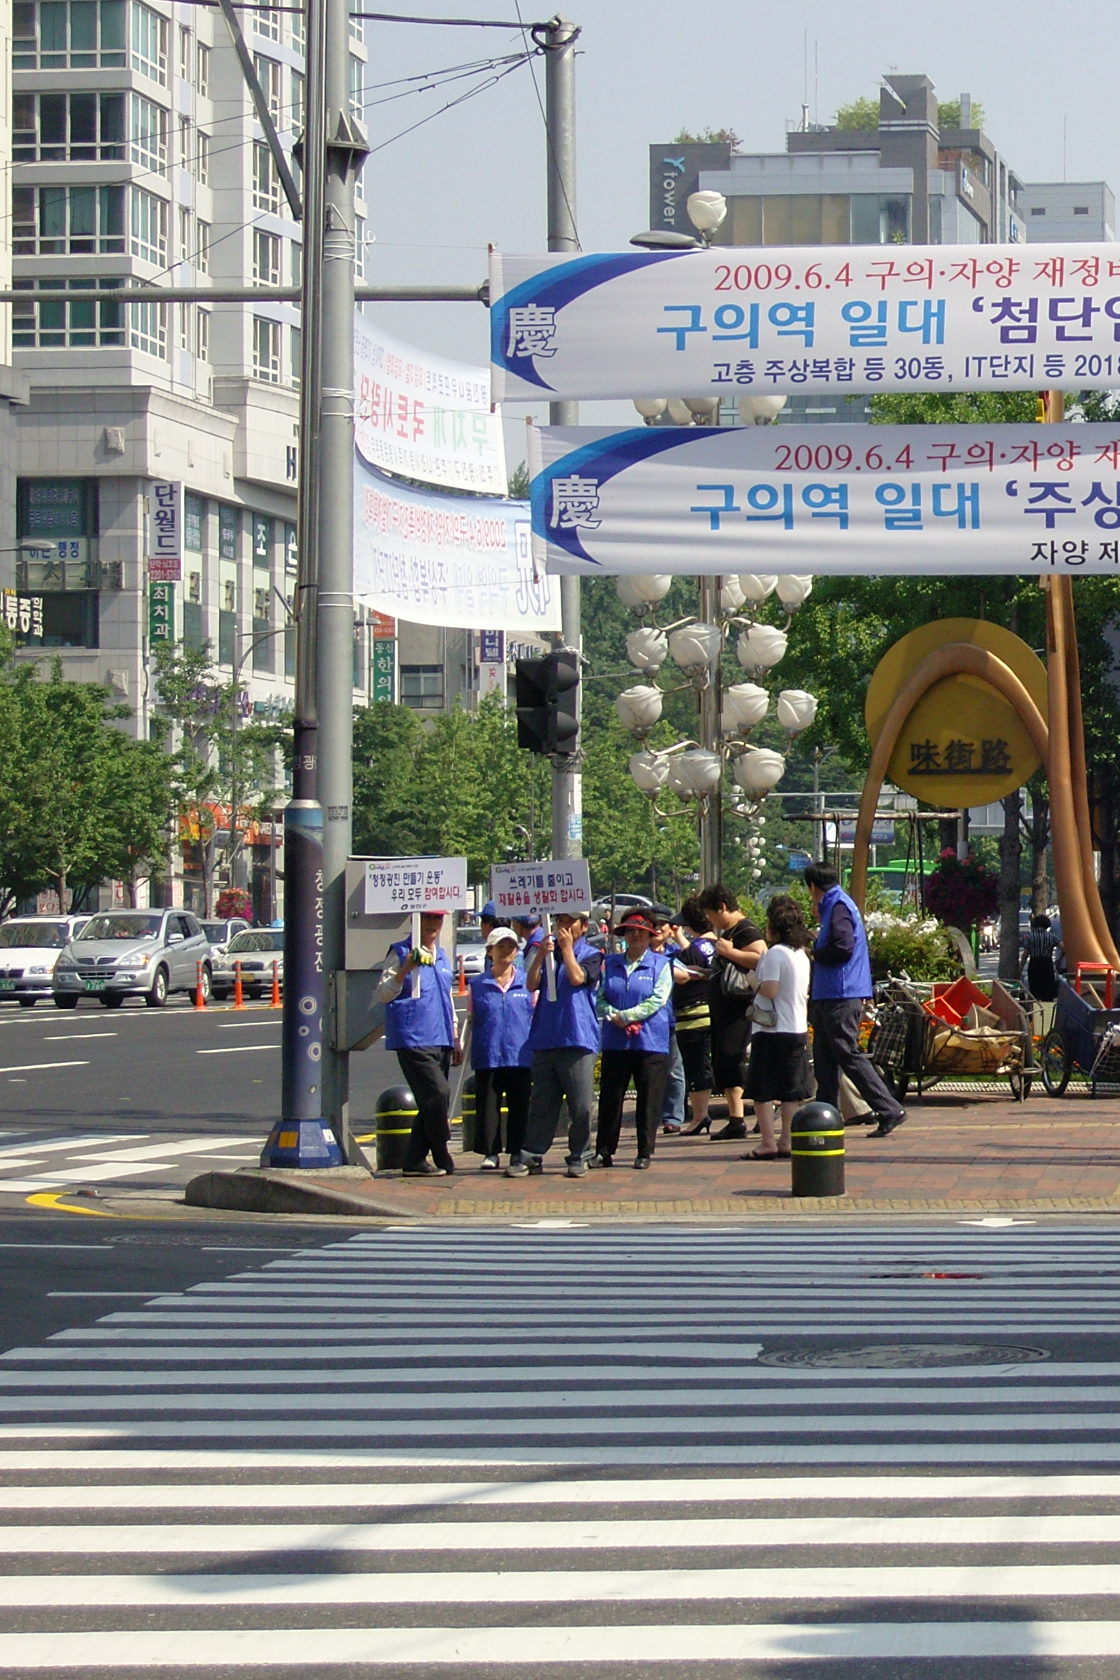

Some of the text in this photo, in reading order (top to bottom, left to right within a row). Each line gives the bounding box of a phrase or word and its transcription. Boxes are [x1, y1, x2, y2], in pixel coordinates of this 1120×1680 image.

[663, 171, 678, 225] tower
[714, 263, 854, 291] 2009.6.4
[865, 258, 1022, 290] 구의·자양
[507, 303, 558, 358] 慶
[656, 301, 815, 351] 구의역
[840, 298, 946, 347] 일대
[711, 359, 755, 385] 고층
[763, 357, 856, 383] 주상복합
[863, 357, 887, 382] 등
[893, 356, 953, 383] 30동,
[964, 354, 1035, 380] IT단지
[1042, 354, 1067, 378] 등
[774, 443, 915, 472] 2009.6.4
[925, 439, 1082, 471] 구의·자양
[153, 483, 178, 556] 단월드
[549, 475, 602, 531] 慶
[690, 483, 851, 532] 구의역
[874, 482, 981, 531] 일대
[1029, 539, 1090, 565] 자양
[152, 586, 171, 640] 최치과
[391, 888, 406, 902] 우리
[407, 887, 422, 901] 모두
[403, 872, 425, 886] 만들기
[509, 874, 544, 889] 쓰레기를
